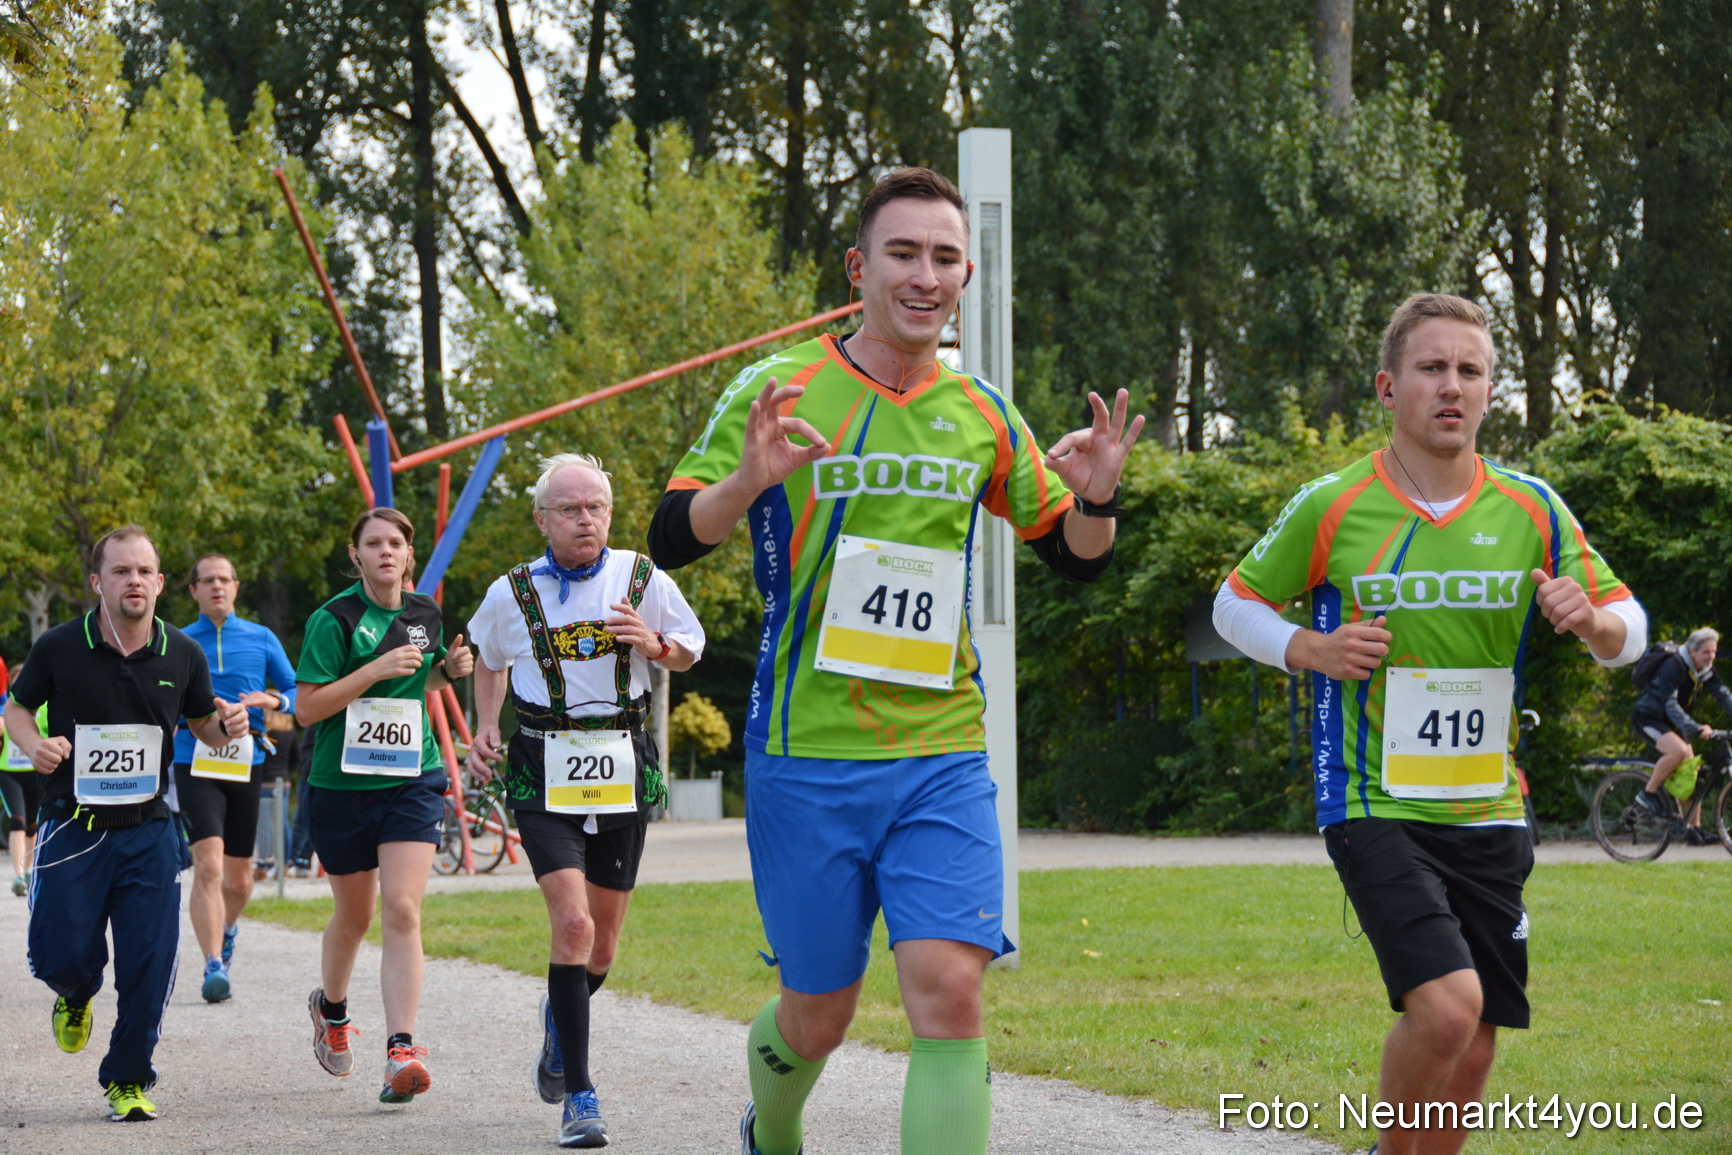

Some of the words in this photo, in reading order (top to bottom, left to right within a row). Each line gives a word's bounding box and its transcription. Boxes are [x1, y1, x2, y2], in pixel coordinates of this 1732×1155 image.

[813, 453, 981, 503] BOCK
[891, 557, 933, 573] BOCK
[1352, 571, 1524, 612] BOCK
[861, 585, 933, 632] 418
[1440, 681, 1482, 692] BOCK
[357, 721, 412, 746] 2460
[1417, 709, 1484, 747] 419
[88, 748, 145, 773] 2251
[368, 752, 398, 762] Andrea
[566, 755, 615, 781] 220
[100, 781, 138, 790] Christian
[582, 789, 602, 799] Willi
